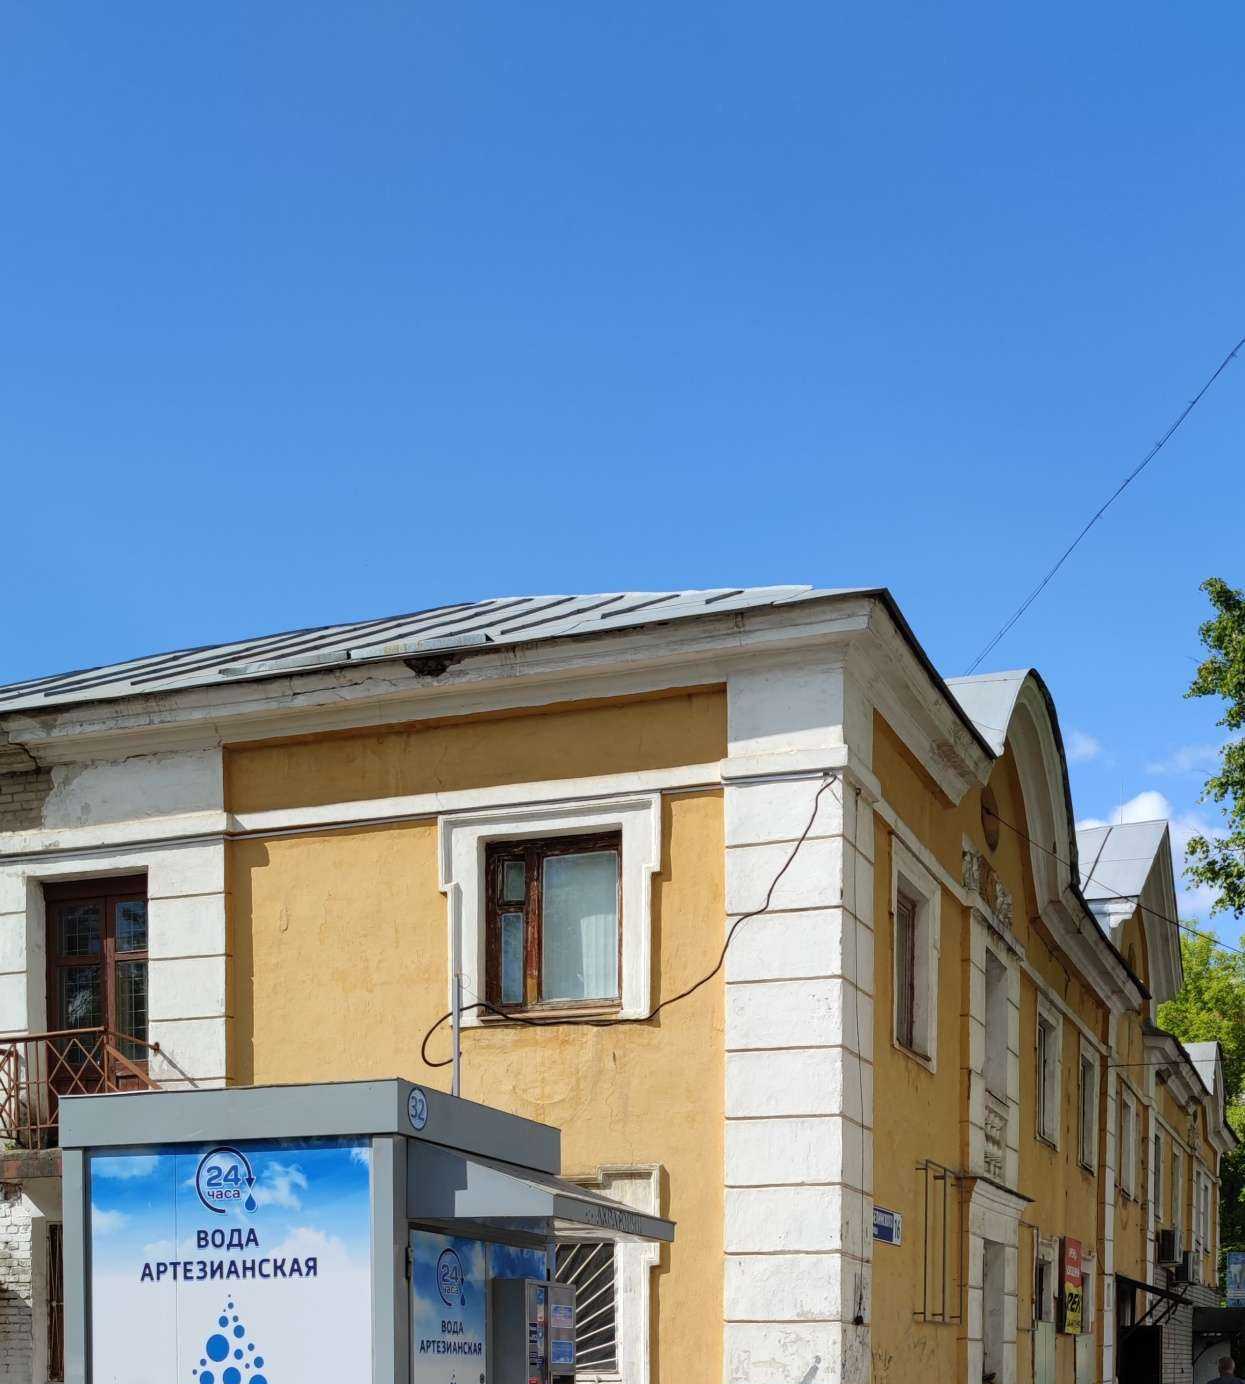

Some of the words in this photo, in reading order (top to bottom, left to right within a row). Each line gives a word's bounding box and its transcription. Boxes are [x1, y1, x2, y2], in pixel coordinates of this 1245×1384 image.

[411, 1096, 424, 1120] 32
[206, 1165, 241, 1187] 24
[207, 1189, 241, 1200] часа
[196, 1228, 260, 1250] ВОДА
[140, 1257, 318, 1282] АРТЕЗИАНСКАЯ
[441, 1264, 459, 1283] 24
[441, 1320, 464, 1336] ВОДА
[419, 1340, 482, 1355] АРТЕЗИАНСКАЯ
